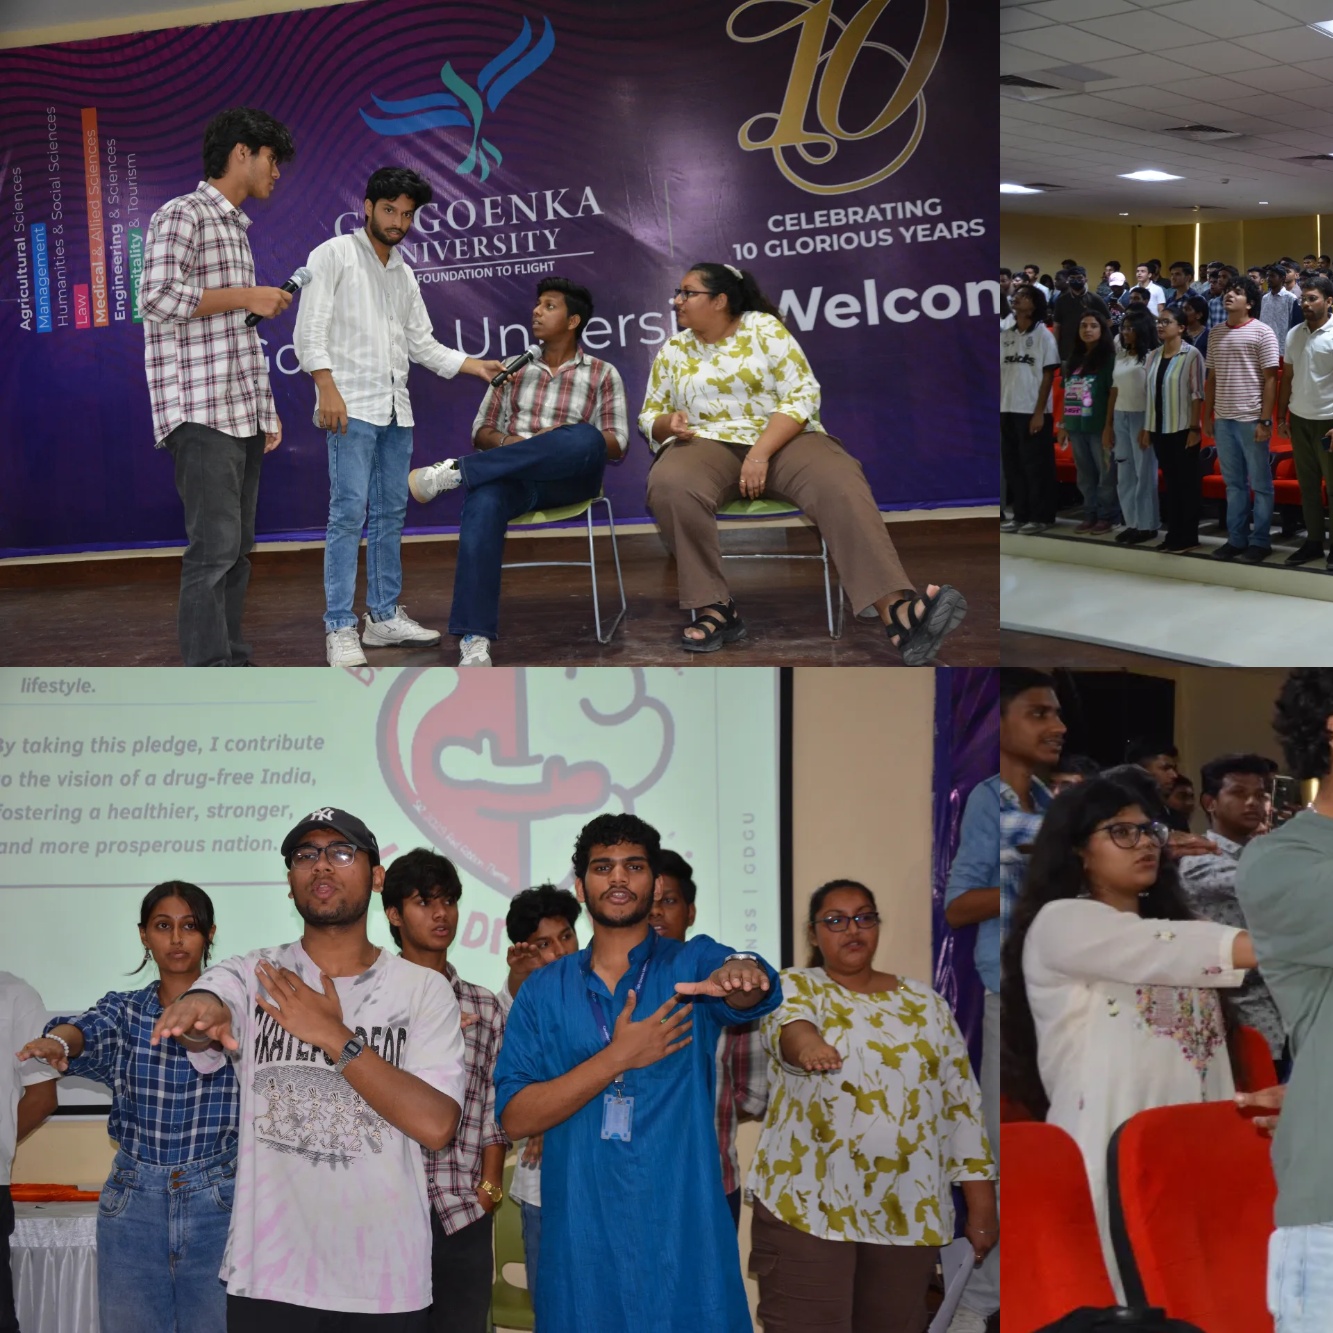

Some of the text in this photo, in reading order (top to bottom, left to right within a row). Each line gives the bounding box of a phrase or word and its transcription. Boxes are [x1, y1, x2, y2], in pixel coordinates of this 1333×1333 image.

[126, 153, 139, 215] Tourism
[47, 106, 68, 327] Humanities & Social Sciences
[87, 130, 106, 323] Medical & Allied Sciences
[129, 218, 140, 228] &
[413, 186, 605, 234] GOENKA
[767, 198, 943, 233] CELEBRATING
[13, 167, 31, 330] Agricultural Sciences
[107, 139, 126, 321] Engineering & Sciences
[399, 228, 562, 265] NIVERSITY
[732, 218, 986, 261] 10 GLORIOUS YEARS
[34, 227, 50, 329] Management
[417, 261, 556, 285] FOUNDATION TO FLIGHT
[77, 294, 87, 325] Law
[20, 677, 97, 697] lifestyle.
[22, 736, 85, 758] taking
[90, 736, 126, 755] this
[132, 735, 203, 757] pledge,
[209, 736, 220, 752] I
[224, 734, 325, 753] contribute
[0, 767, 317, 790] o the vision of a drug-free India,
[89, 807, 101, 821] a
[107, 803, 200, 822] healthier,
[206, 803, 294, 822] stronger,
[39, 840, 89, 856] more
[95, 837, 206, 858] prosperous
[212, 836, 278, 854] nation.
[742, 812, 756, 875] GDGU
[744, 908, 758, 950] NSS
